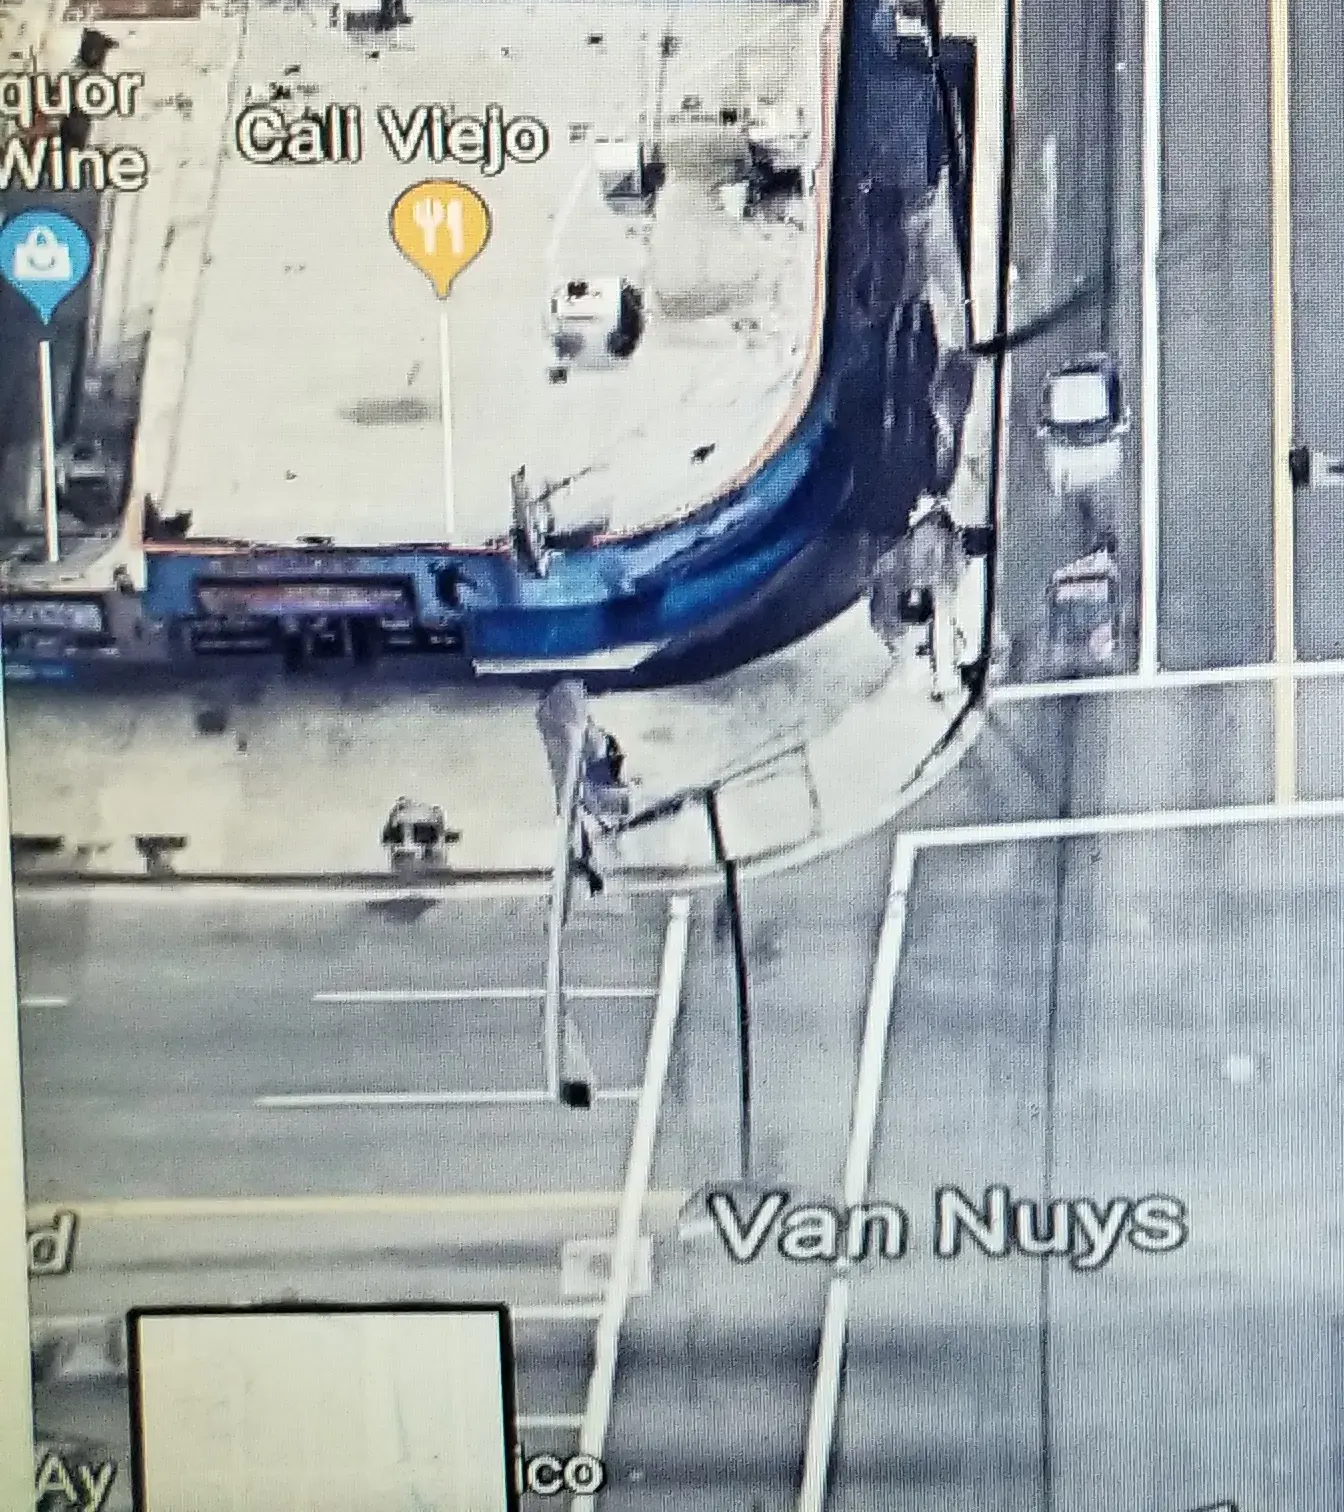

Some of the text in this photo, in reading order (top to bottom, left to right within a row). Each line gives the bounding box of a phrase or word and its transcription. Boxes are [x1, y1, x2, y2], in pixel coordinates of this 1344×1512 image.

[0, 73, 144, 129] quor
[237, 105, 549, 175] Cali Viejo
[706, 1185, 1188, 1271] Van Nuys
